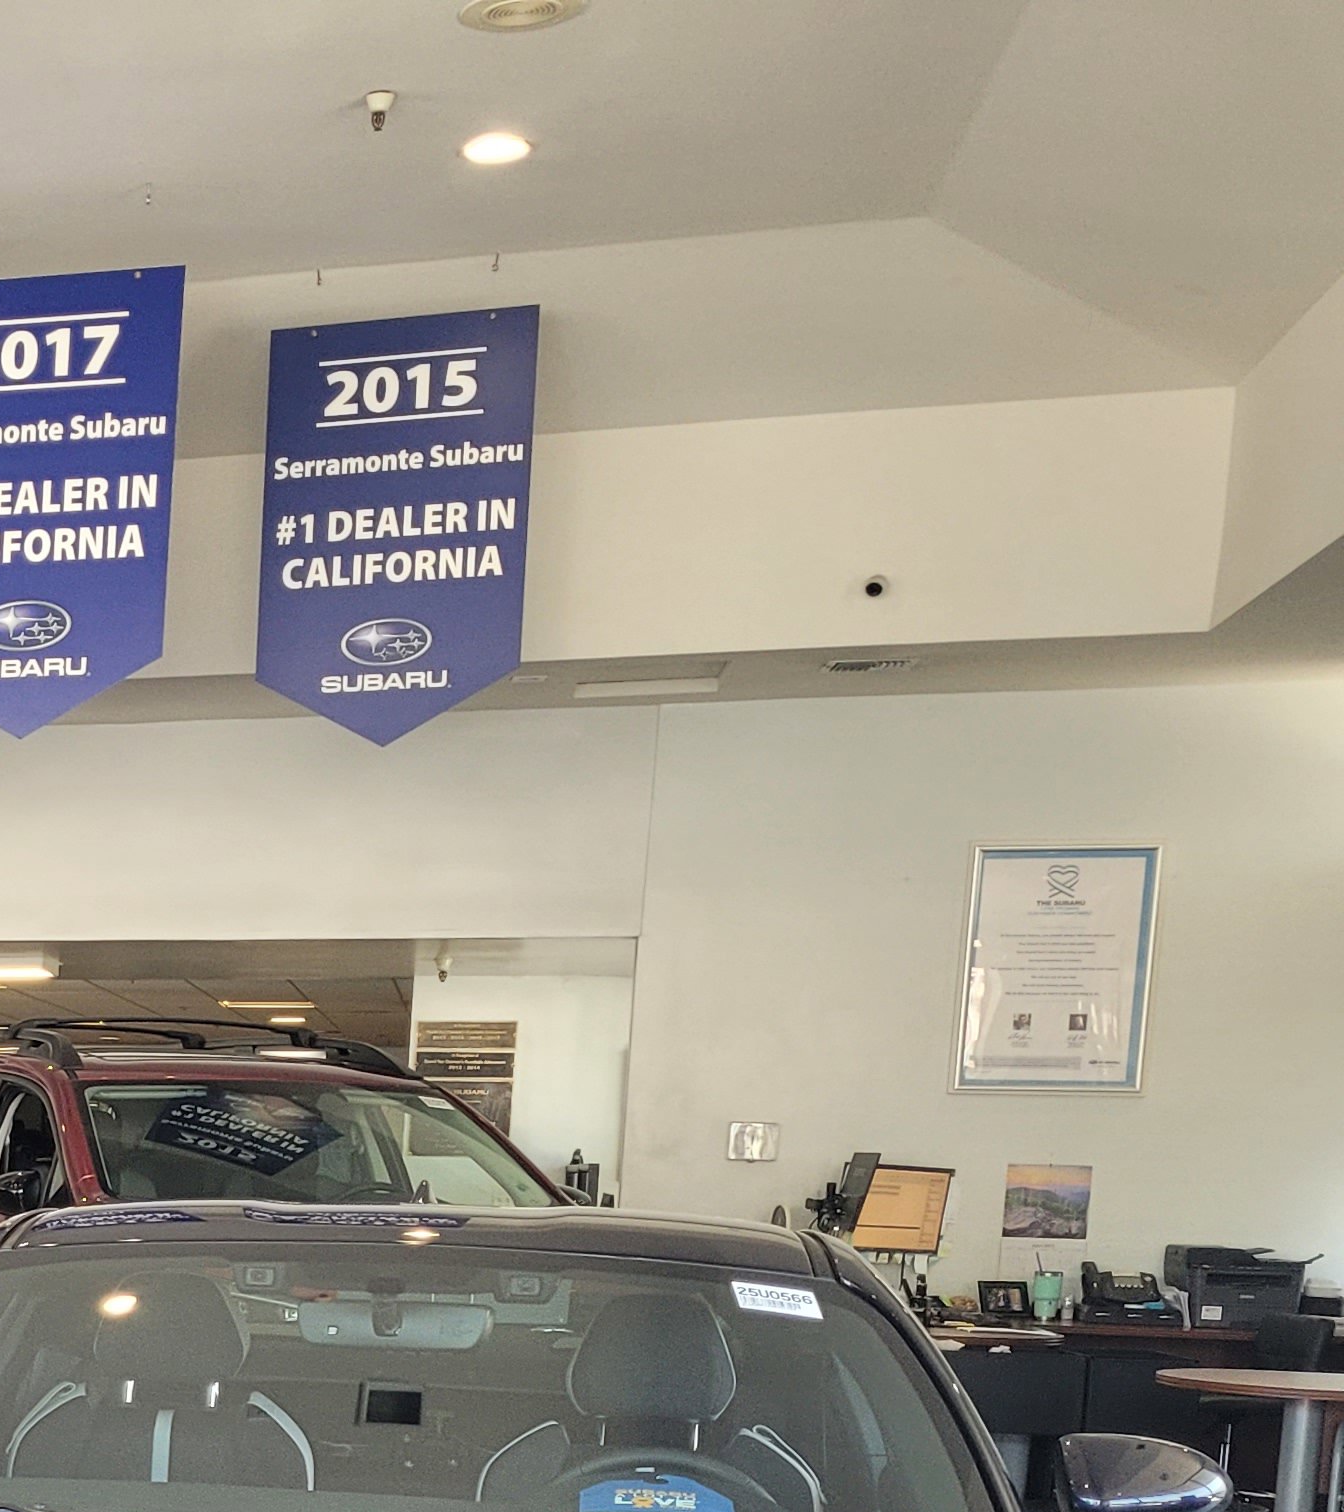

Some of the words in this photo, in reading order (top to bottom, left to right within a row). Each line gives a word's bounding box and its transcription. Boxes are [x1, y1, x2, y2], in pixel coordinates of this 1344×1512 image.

[323, 359, 478, 417] 2015
[69, 413, 167, 441] Subaru
[274, 452, 424, 480] Serramonte
[429, 441, 524, 468] Subaru
[118, 473, 158, 509] IN
[276, 513, 315, 546] #1
[327, 501, 469, 543] DEALER
[477, 497, 516, 532] IN
[281, 545, 504, 590] CALIFORNIA
[320, 669, 450, 694] SUBARU
[736, 1287, 813, 1305] 25U0566
